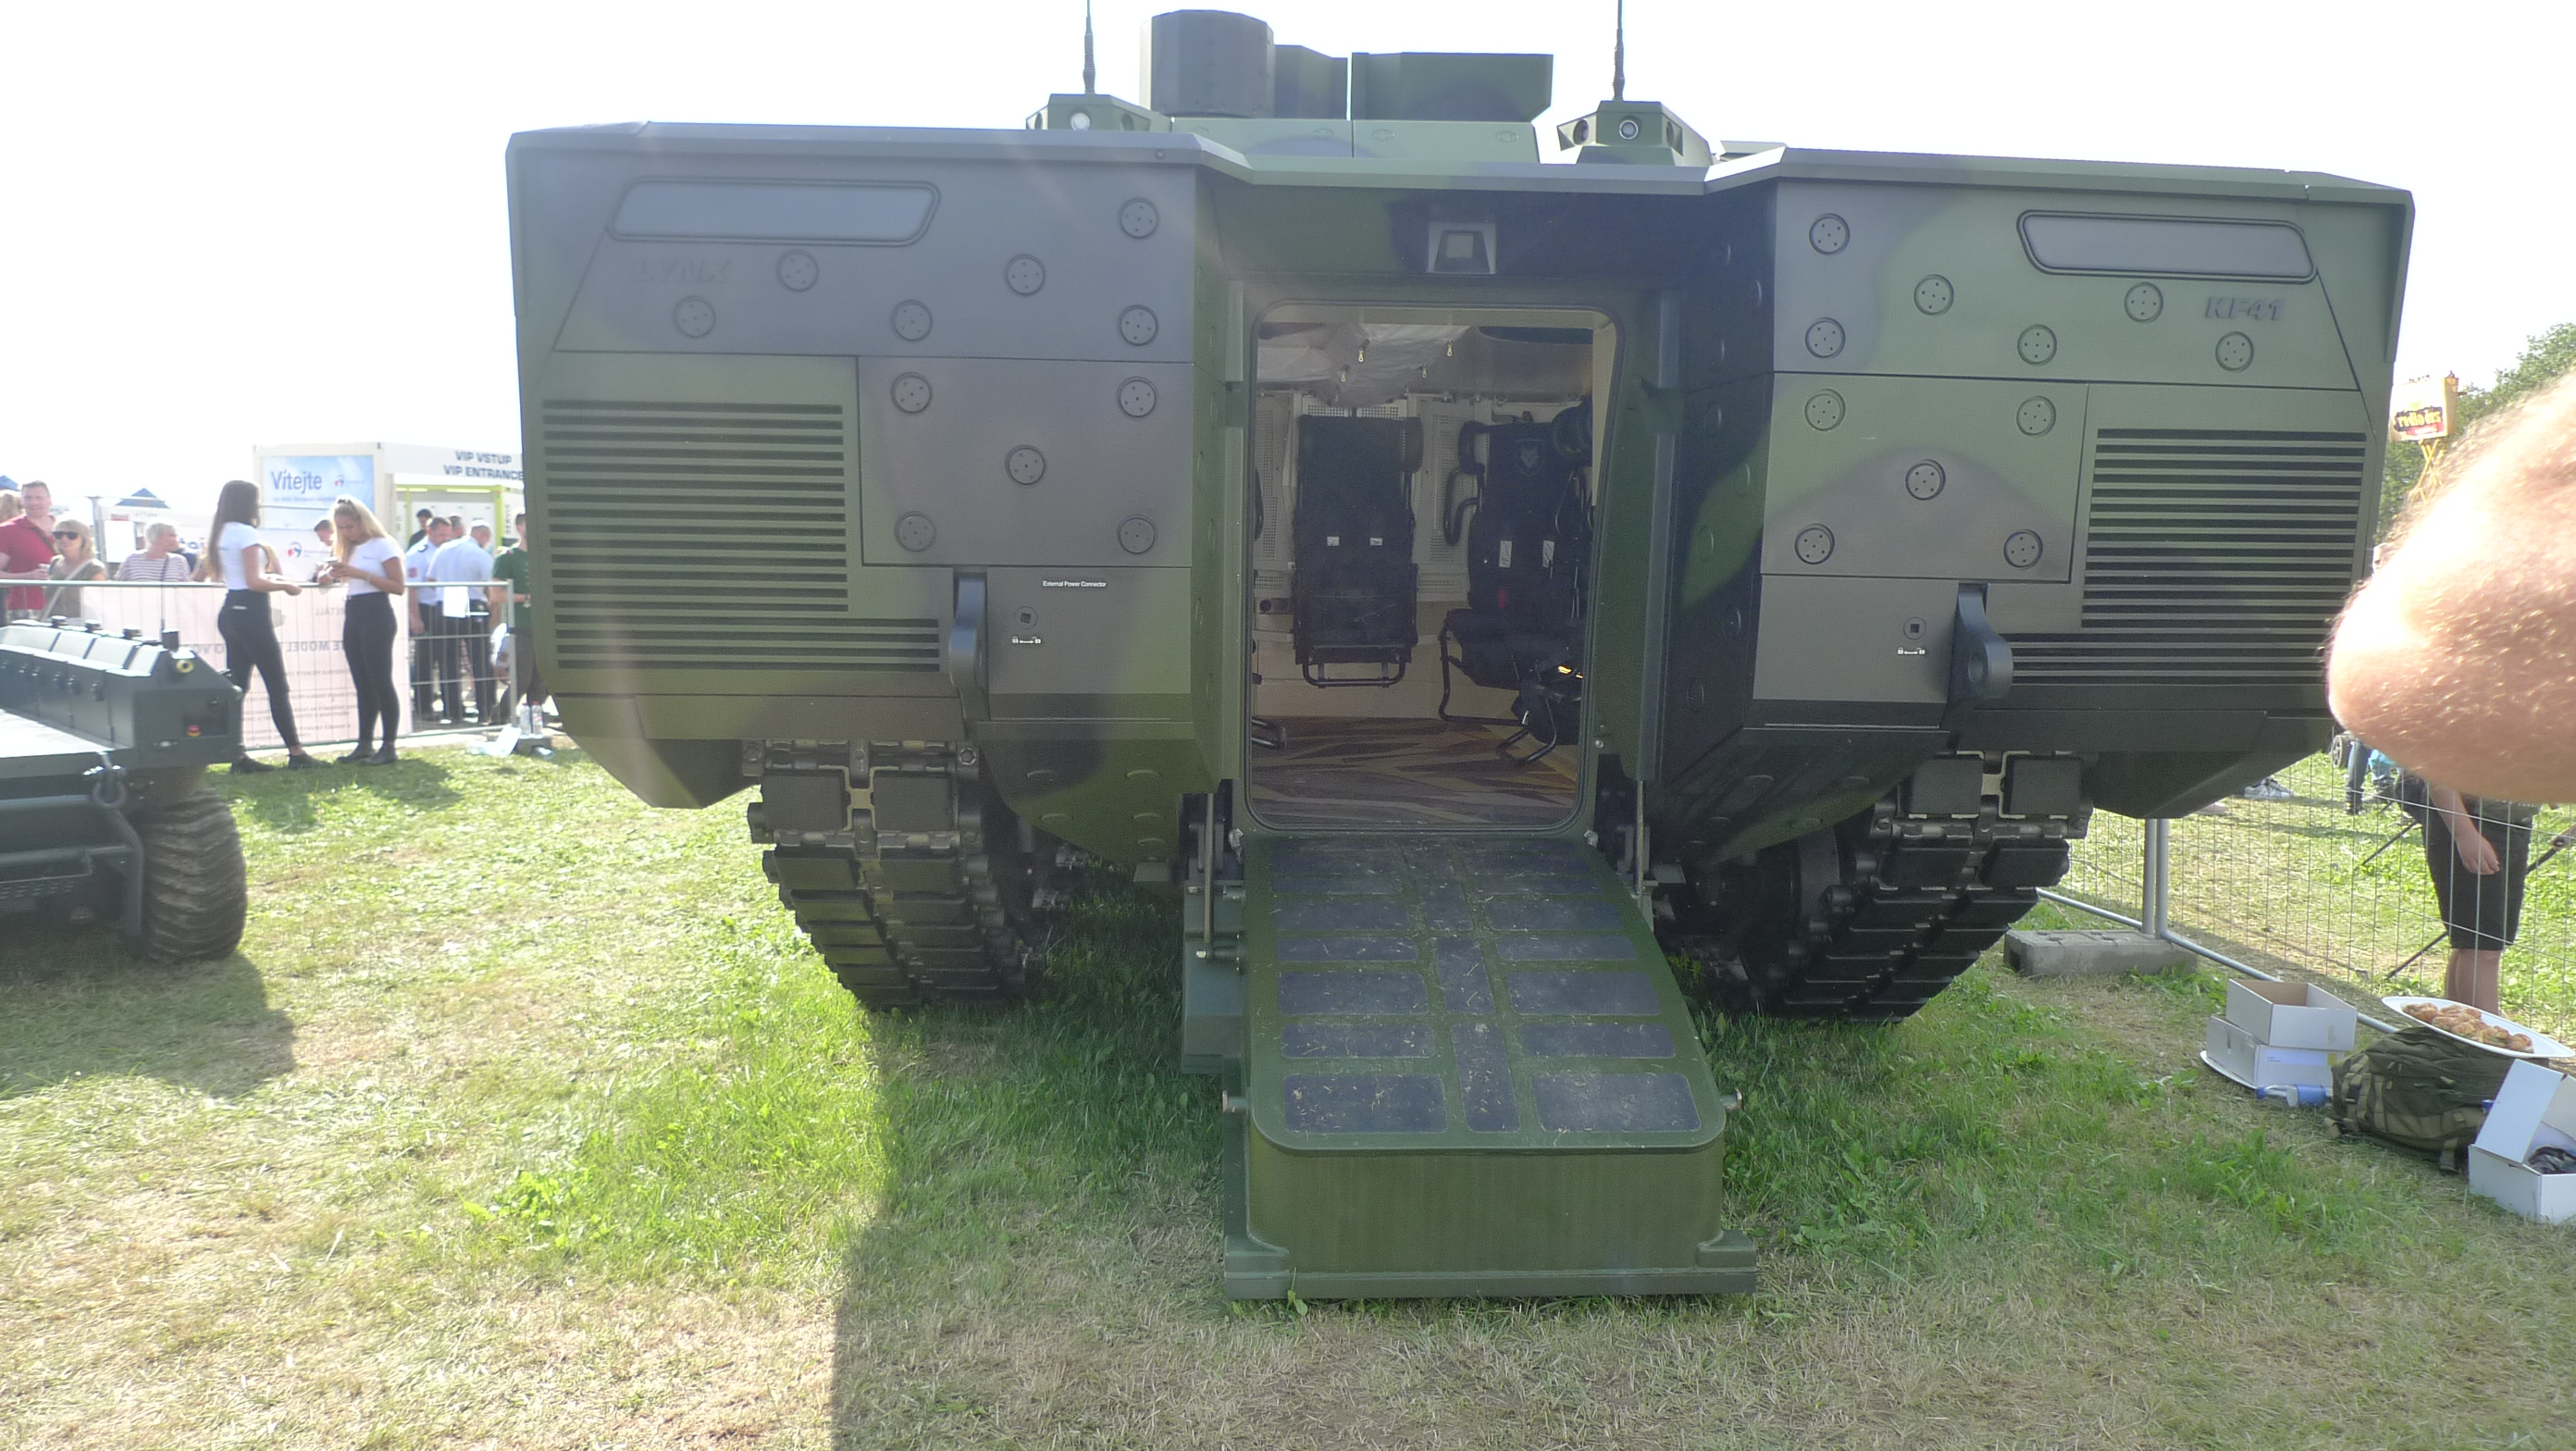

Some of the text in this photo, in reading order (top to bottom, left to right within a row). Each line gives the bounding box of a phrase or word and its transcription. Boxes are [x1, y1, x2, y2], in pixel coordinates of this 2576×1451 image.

[633, 258, 731, 283] LYNX
[2204, 296, 2285, 321] KF41
[455, 450, 513, 465] VIP VSTUP
[270, 469, 323, 494] Vítejte
[443, 465, 525, 481] VIP ENTRANCE
